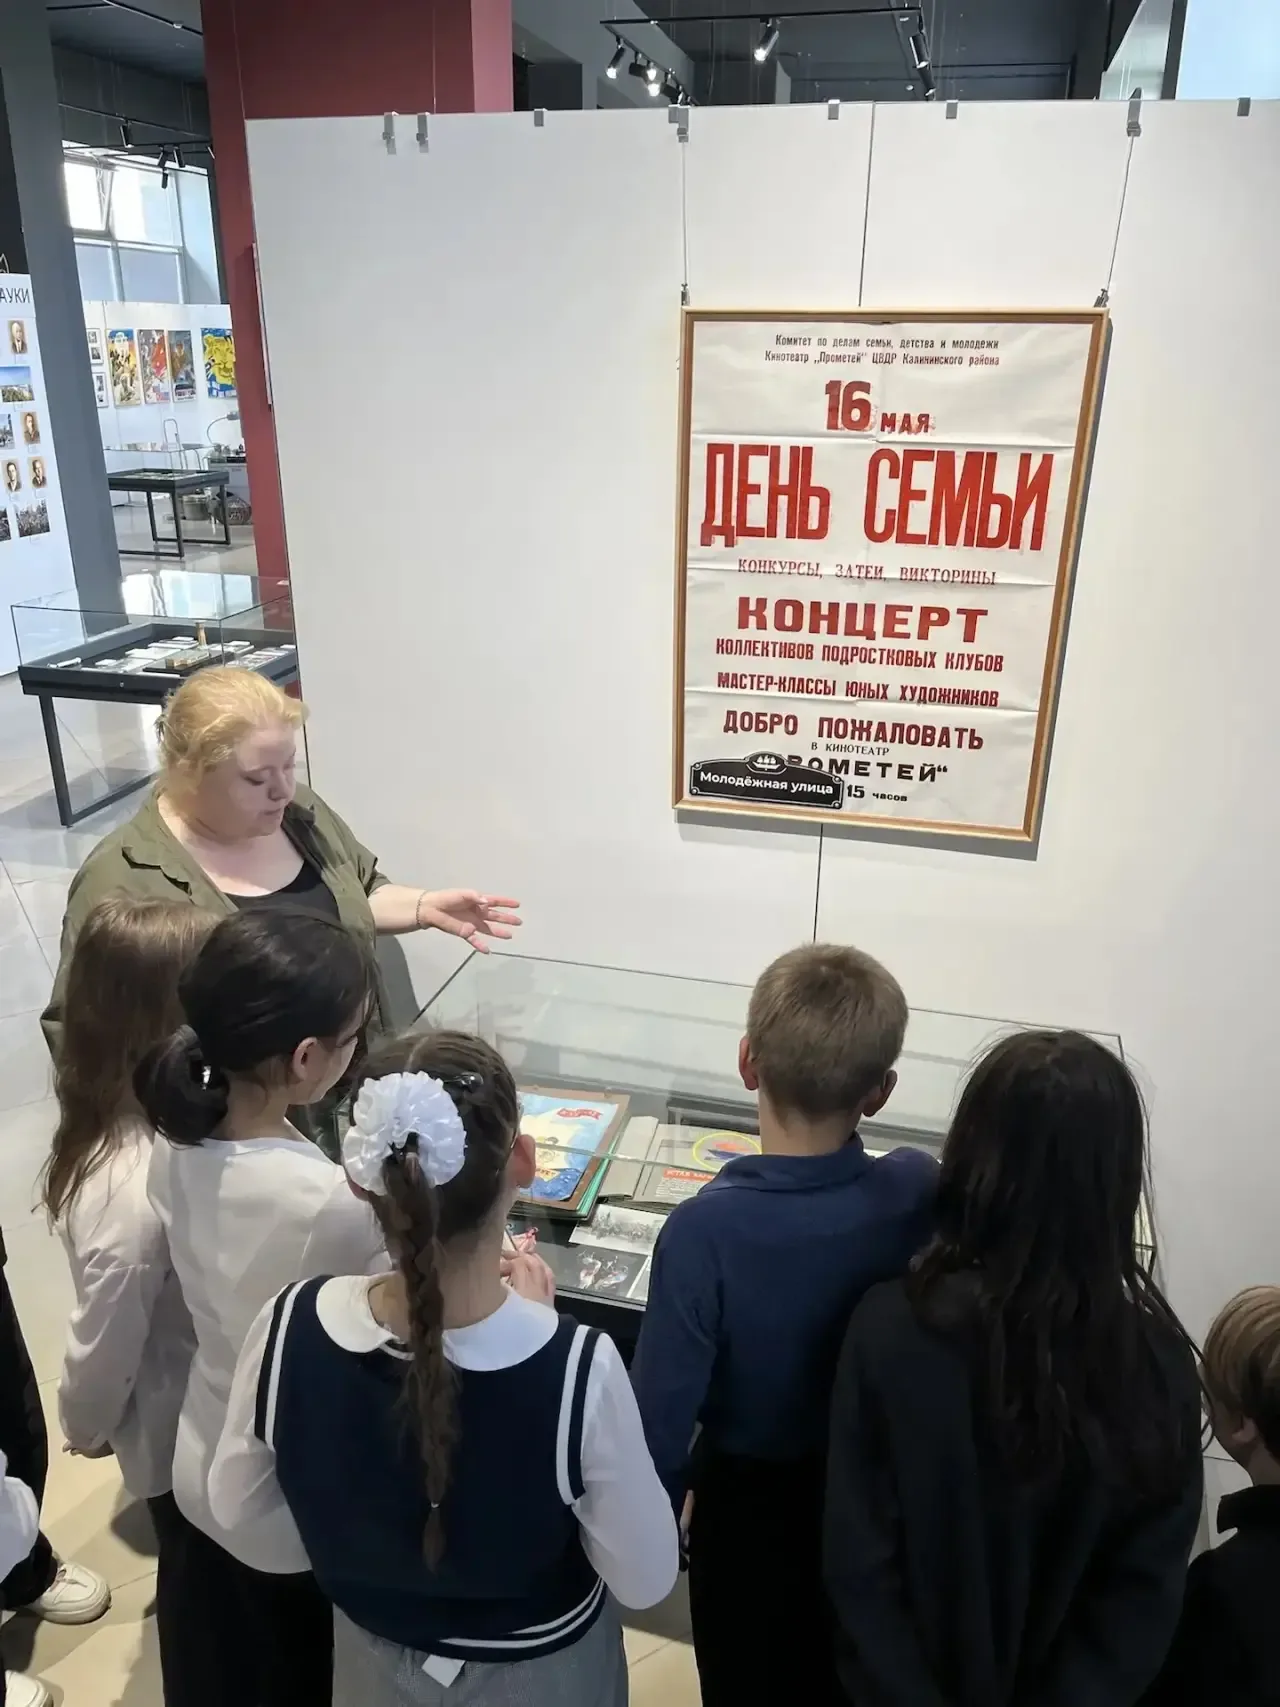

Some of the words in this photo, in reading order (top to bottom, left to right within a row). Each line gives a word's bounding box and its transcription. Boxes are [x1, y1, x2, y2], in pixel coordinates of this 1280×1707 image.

[775, 335, 812, 346] Комитет
[817, 338, 827, 347] по
[832, 338, 860, 348] делам
[865, 339, 894, 349] семьи,
[899, 339, 935, 349] детства
[940, 339, 946, 349] и
[951, 339, 999, 350] молодежи
[765, 351, 809, 363] Кинотеатр
[872, 353, 897, 365] ЦВДР
[902, 353, 963, 366] Калининского
[968, 355, 1000, 367] района
[825, 380, 871, 432] 16
[880, 412, 930, 434] МАЯ
[700, 443, 831, 548] ДЕНЬ
[863, 448, 1055, 551] СЕМЬИ
[738, 559, 824, 579] КОНКУРСЫ,
[835, 564, 888, 582] ЗАТЕИ,
[899, 567, 997, 586] ВИКТОРИНЫ
[737, 596, 989, 643] КОНЦЕРТ
[716, 638, 814, 661] КОЛЛЕКТИВОВ
[821, 644, 937, 669] ПОДРОСТКОВЫХ
[944, 652, 1004, 673] КЛУБОВ
[717, 672, 837, 697] МАСТЕР-КЛАССЫ
[845, 680, 890, 701] ЮНЫХ
[899, 684, 1000, 708] ХУДОЖНИКОВ
[723, 710, 799, 736] ДОБРО
[818, 717, 984, 749] ПОЖАЛОВАТЬ
[811, 742, 818, 751] В
[825, 743, 889, 757] КИНОТЕАТР
[700, 771, 788, 791] Молодёжная
[791, 780, 833, 795] улица
[787, 755, 948, 783] РОМЕТЕЙ“
[847, 785, 865, 799] 15
[872, 792, 908, 802] часов
